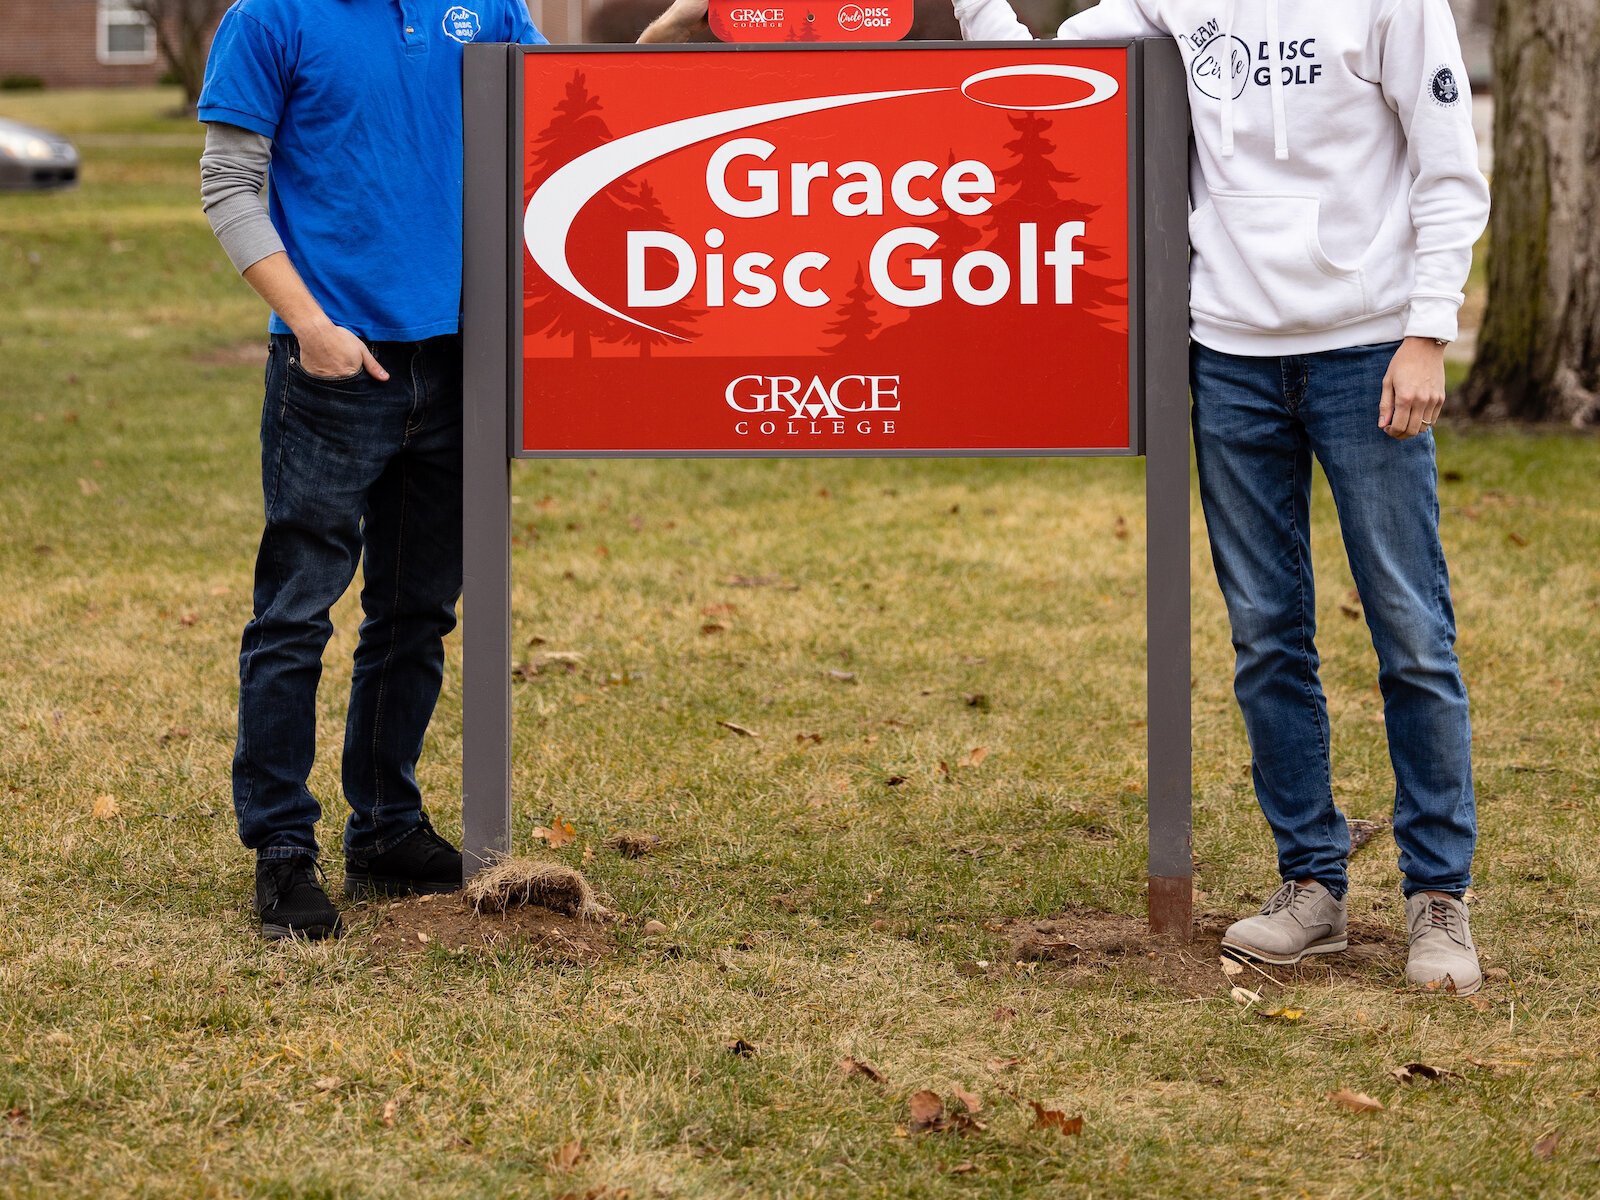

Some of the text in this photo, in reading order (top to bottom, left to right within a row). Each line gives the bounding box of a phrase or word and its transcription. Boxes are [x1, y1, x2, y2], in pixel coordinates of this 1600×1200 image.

[730, 8, 784, 22] GRACE
[840, 10, 862, 24] Circle
[864, 8, 888, 16] DISC
[864, 18, 892, 27] GOLF
[1178, 18, 1220, 52] TEAM
[1254, 64, 1322, 86] GOLF
[706, 138, 996, 218] Grace
[626, 222, 1086, 308] Disc Golf
[725, 375, 900, 419] GRACE
[735, 421, 896, 435] COLLEGE
